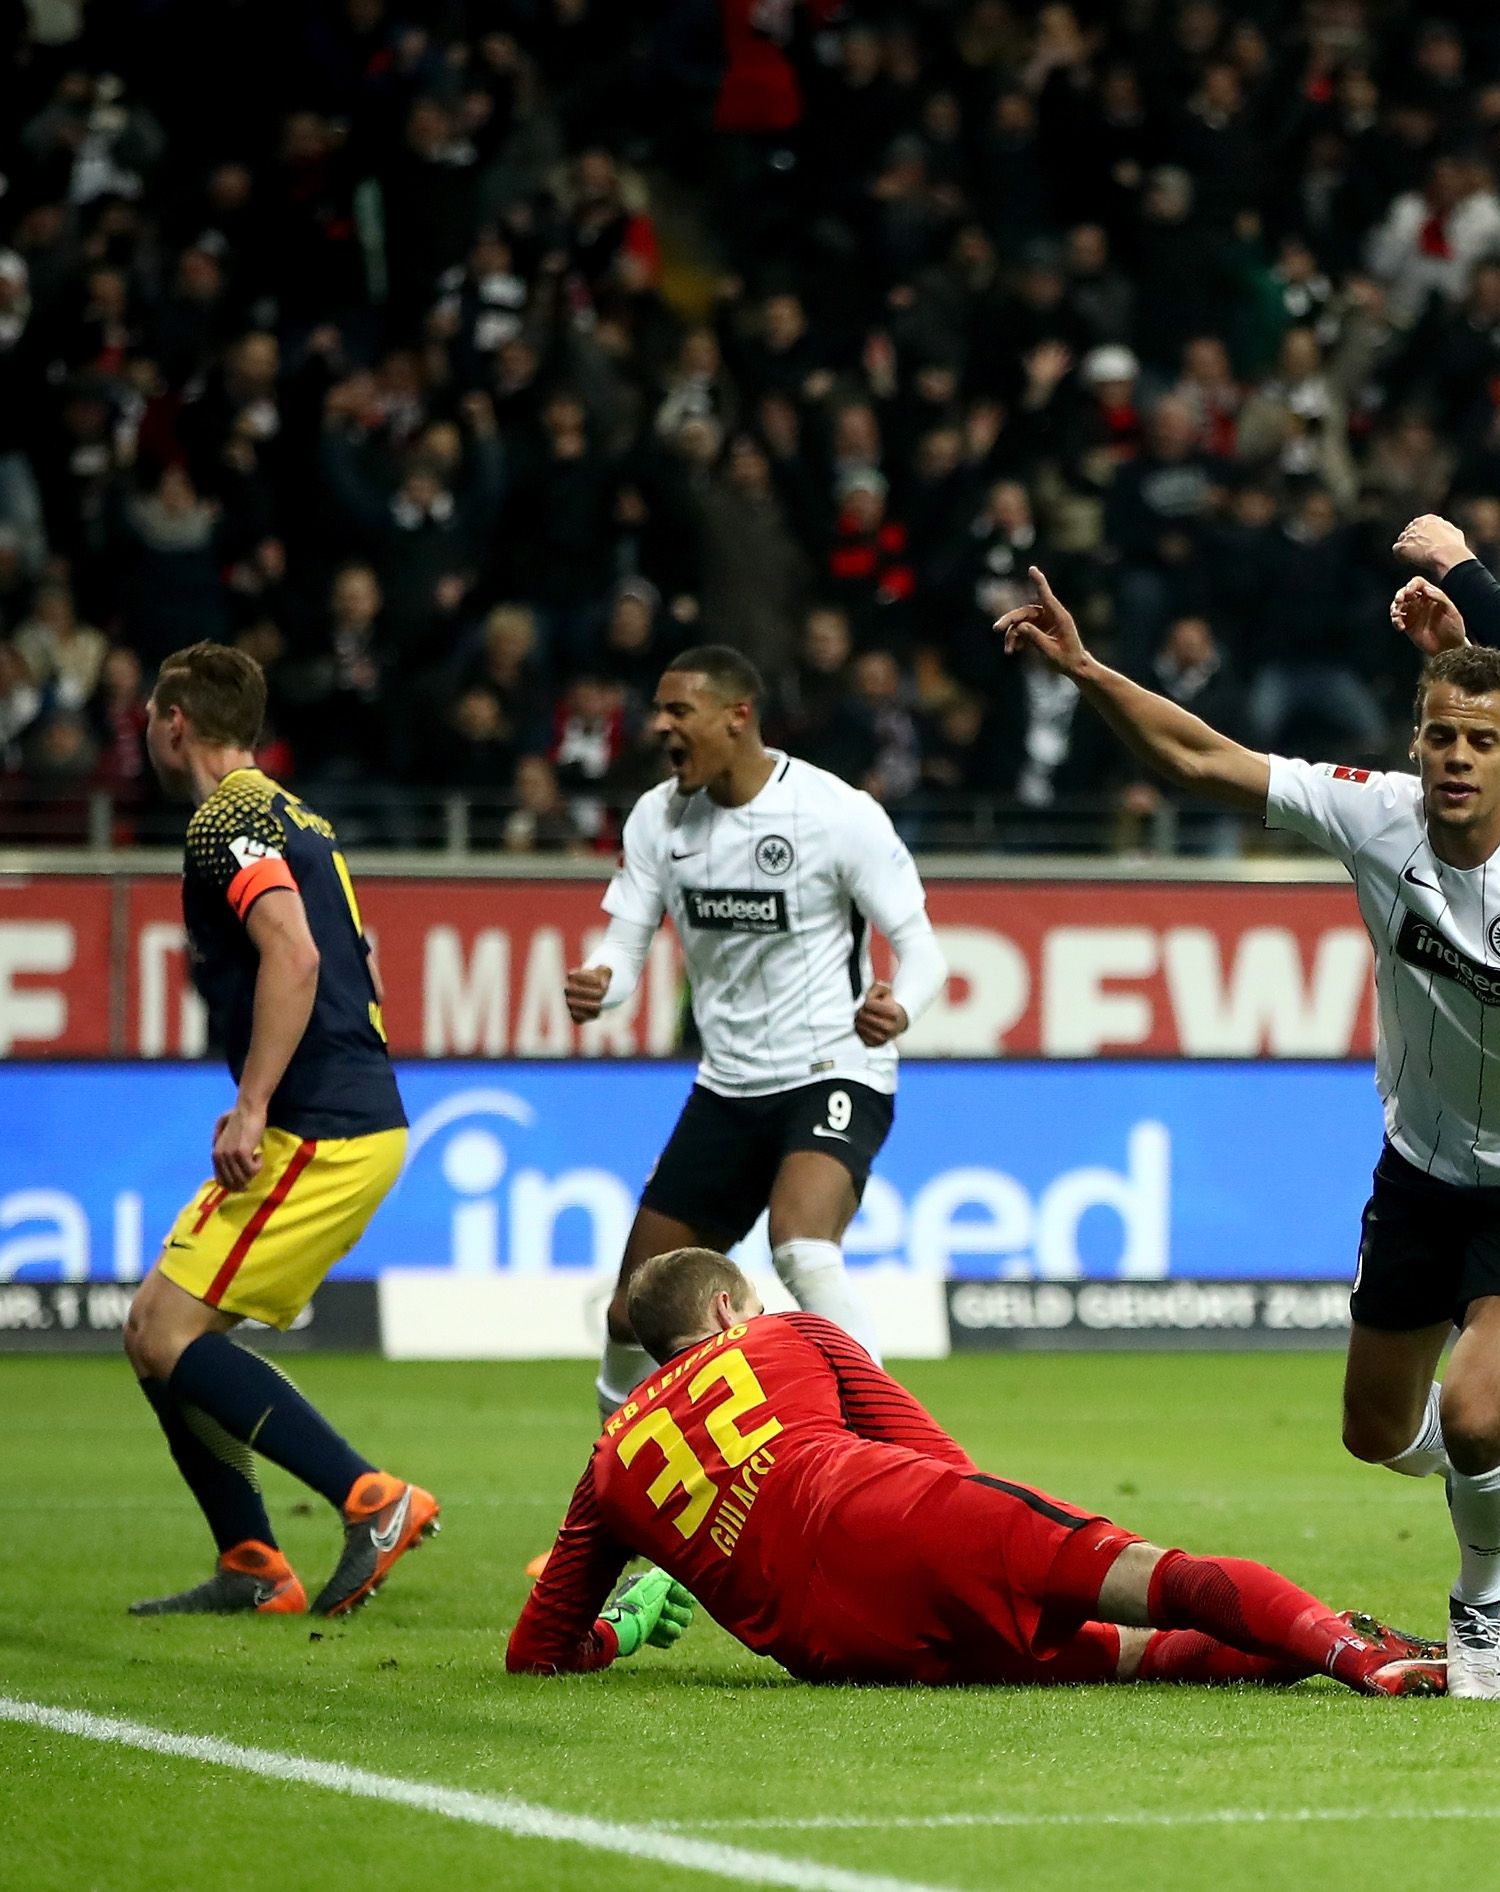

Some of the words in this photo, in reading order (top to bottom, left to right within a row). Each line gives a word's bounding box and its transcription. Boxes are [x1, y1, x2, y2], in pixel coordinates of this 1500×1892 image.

[694, 893, 778, 921] indeed
[827, 1088, 853, 1132] 9
[604, 1401, 640, 1438] RB
[646, 1322, 749, 1401] LEIPZIG
[616, 1347, 785, 1541] 32
